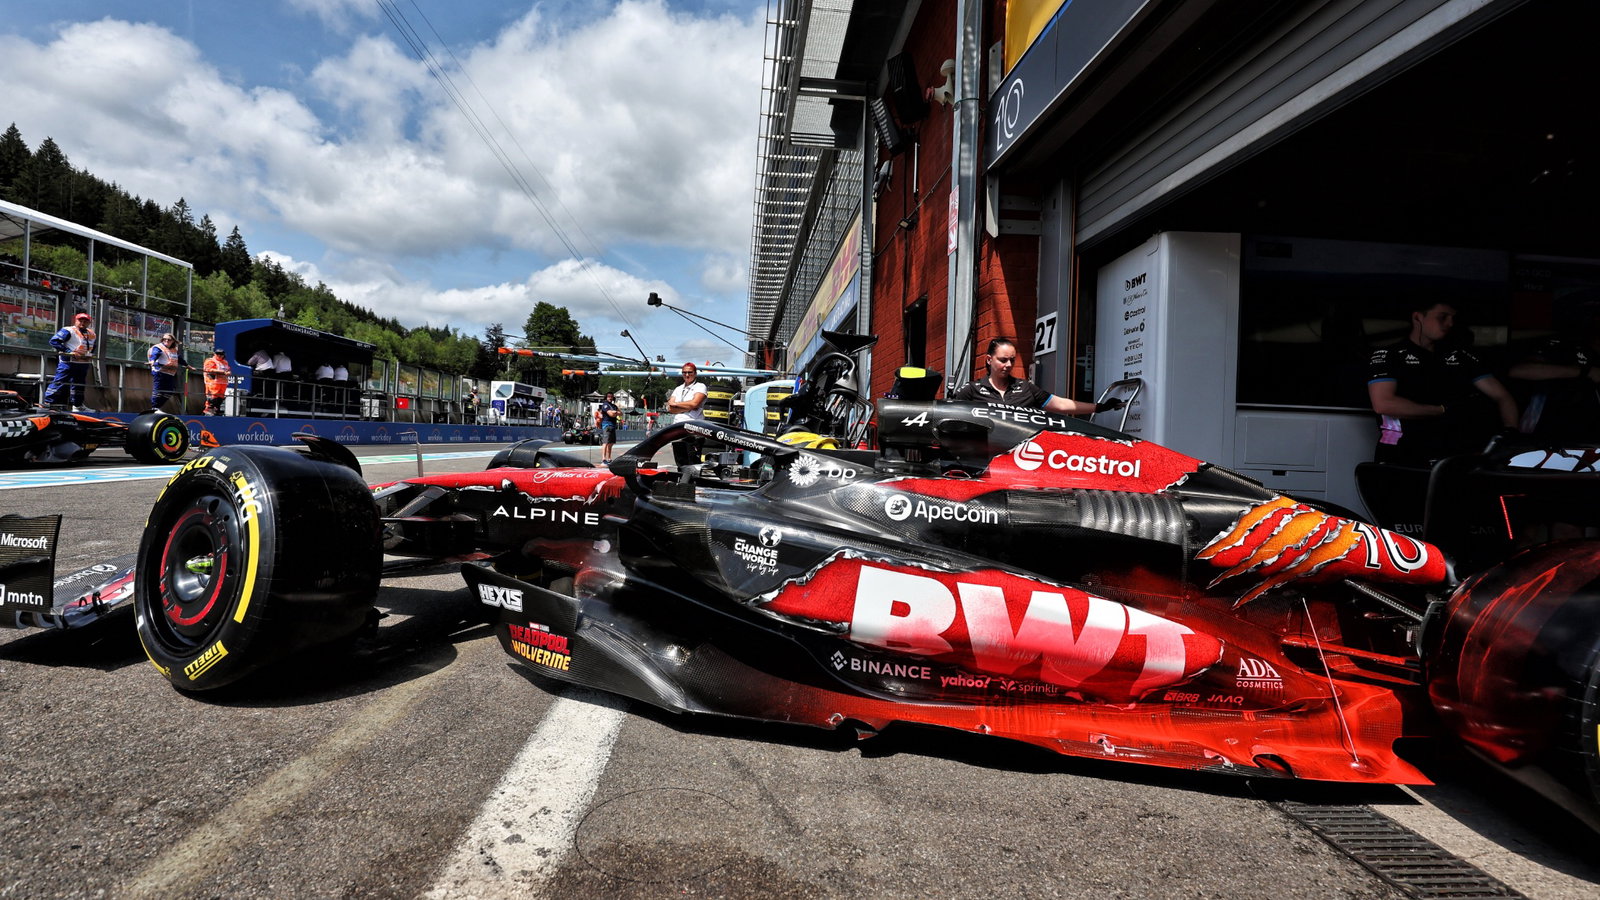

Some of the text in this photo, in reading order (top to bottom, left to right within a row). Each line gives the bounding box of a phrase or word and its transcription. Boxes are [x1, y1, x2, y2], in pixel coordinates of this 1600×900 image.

[1035, 317, 1057, 352] 27
[971, 407, 1066, 428] E-TECH
[987, 402, 1047, 415] RENAULT
[237, 430, 275, 443] workday
[335, 433, 360, 443] workday
[724, 433, 767, 451] businessolver
[1048, 449, 1141, 478] Castrol
[493, 505, 599, 525] ALPINE
[914, 500, 999, 525] ApeCoin
[1, 532, 48, 549] Microsoft
[735, 542, 778, 559] CHANGE
[1351, 521, 1428, 574] 10
[742, 552, 777, 567] WORLD
[7, 591, 44, 606] mntn
[478, 583, 524, 613] HEXIS
[509, 623, 571, 655] DEADPOOL
[850, 565, 1195, 702] BWT
[183, 639, 229, 681] PIRELLI
[511, 639, 572, 671] WOLVERINE
[850, 657, 932, 680] BINANCE
[1236, 657, 1281, 678] ADA
[940, 674, 992, 689] yahoo!
[1018, 682, 1059, 694] sprinklr
[1236, 680, 1284, 689] COSMETICS
[1176, 692, 1200, 703] BRB
